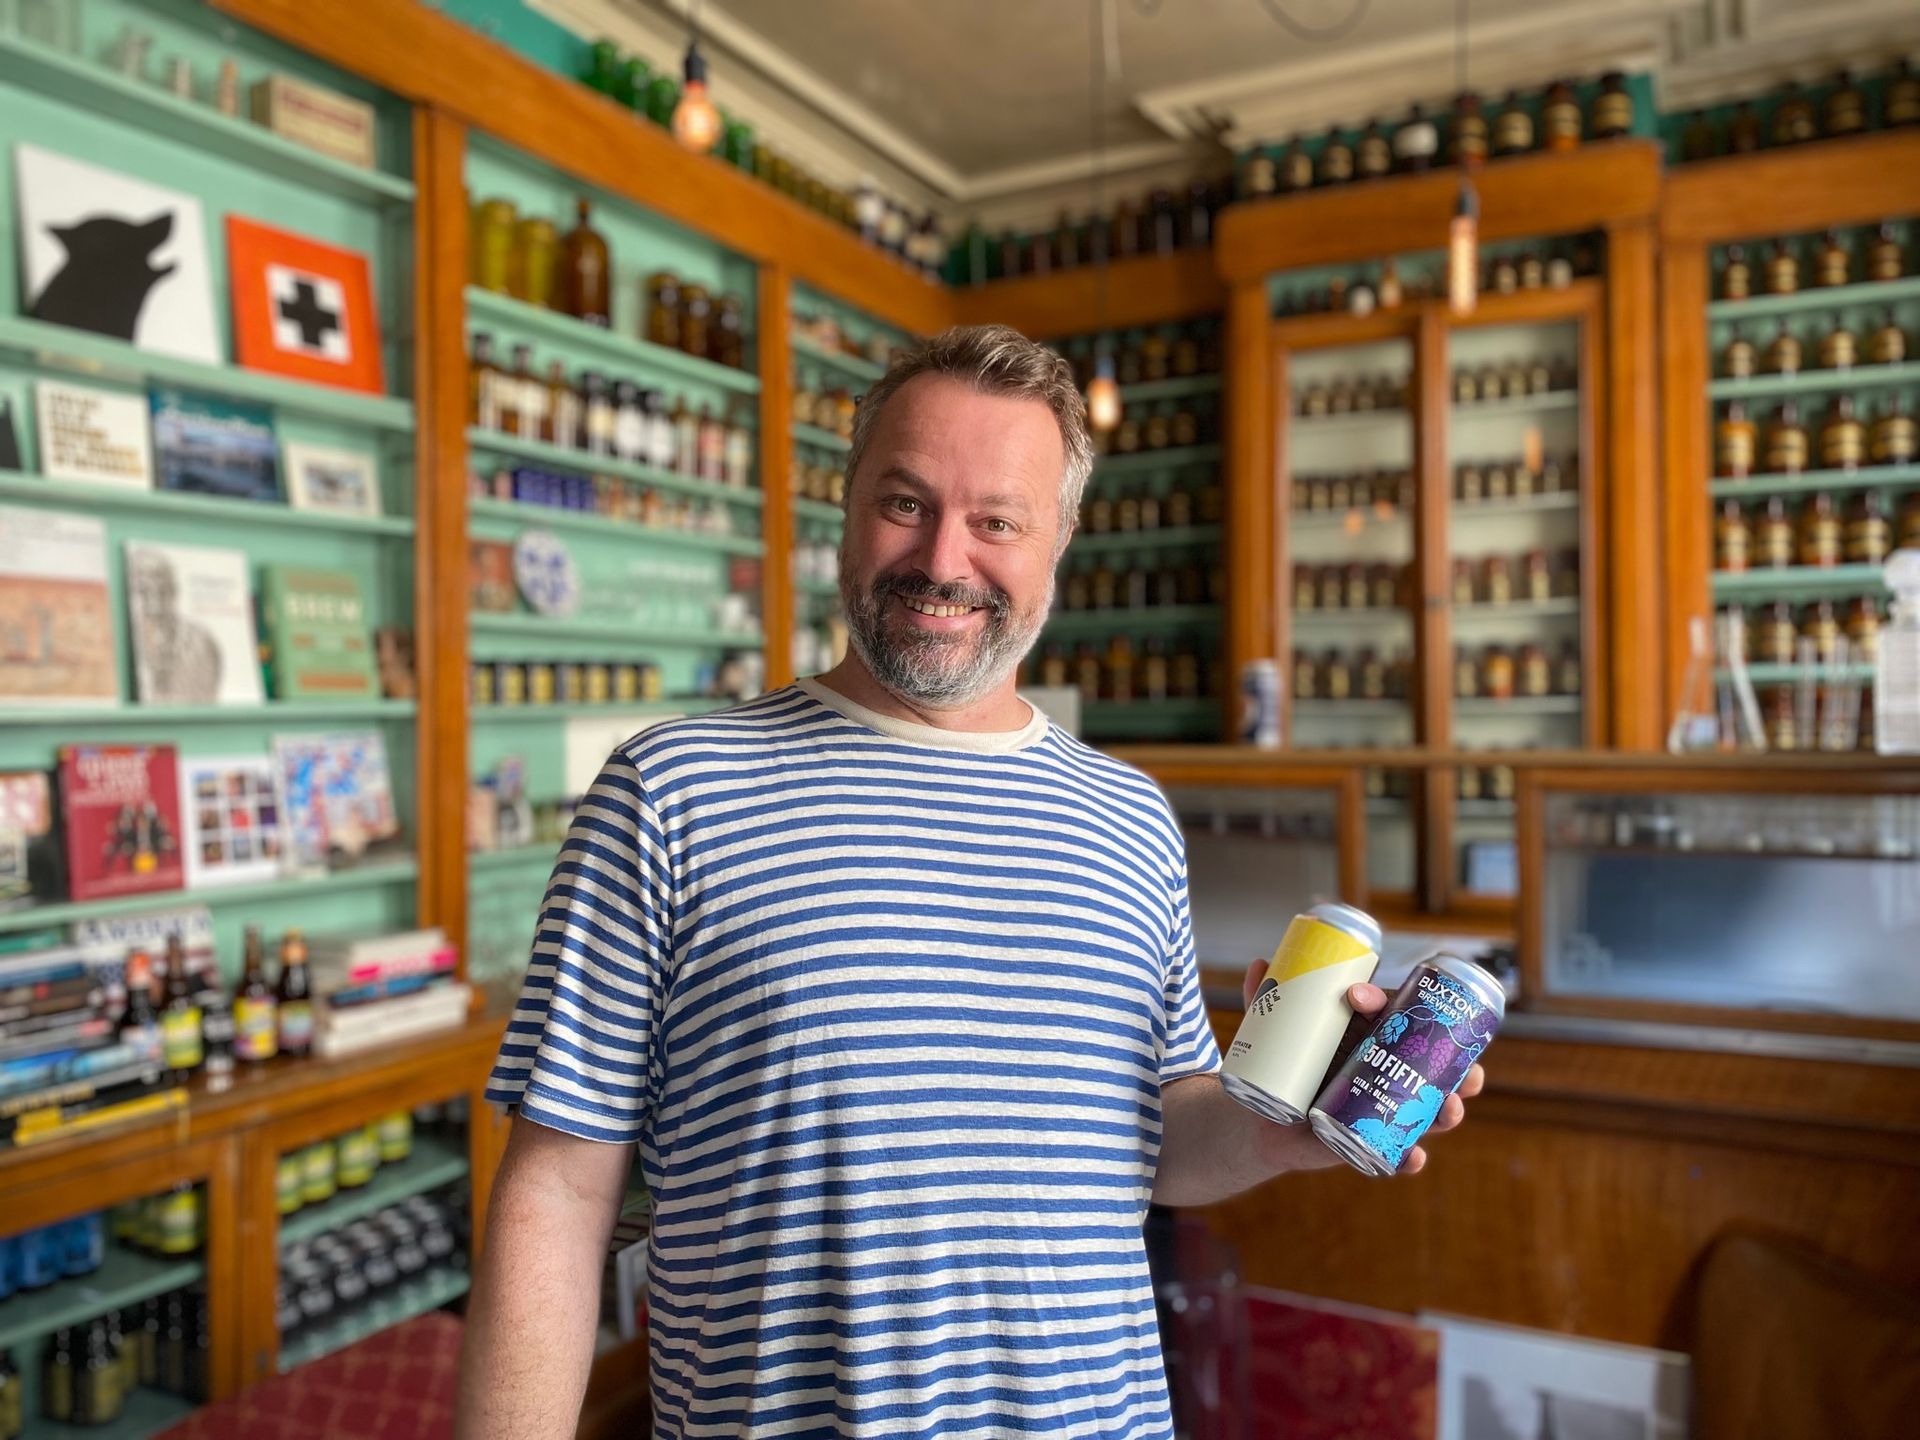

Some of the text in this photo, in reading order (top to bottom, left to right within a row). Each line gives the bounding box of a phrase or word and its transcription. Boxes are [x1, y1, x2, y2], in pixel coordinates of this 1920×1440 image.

[1271, 989, 1280, 1002] Full
[1418, 976, 1478, 1020] BUXTON
[1418, 990, 1462, 1021] BREWERY
[1352, 1076, 1371, 1091] CITRA
[1373, 1075, 1391, 1091] IPA
